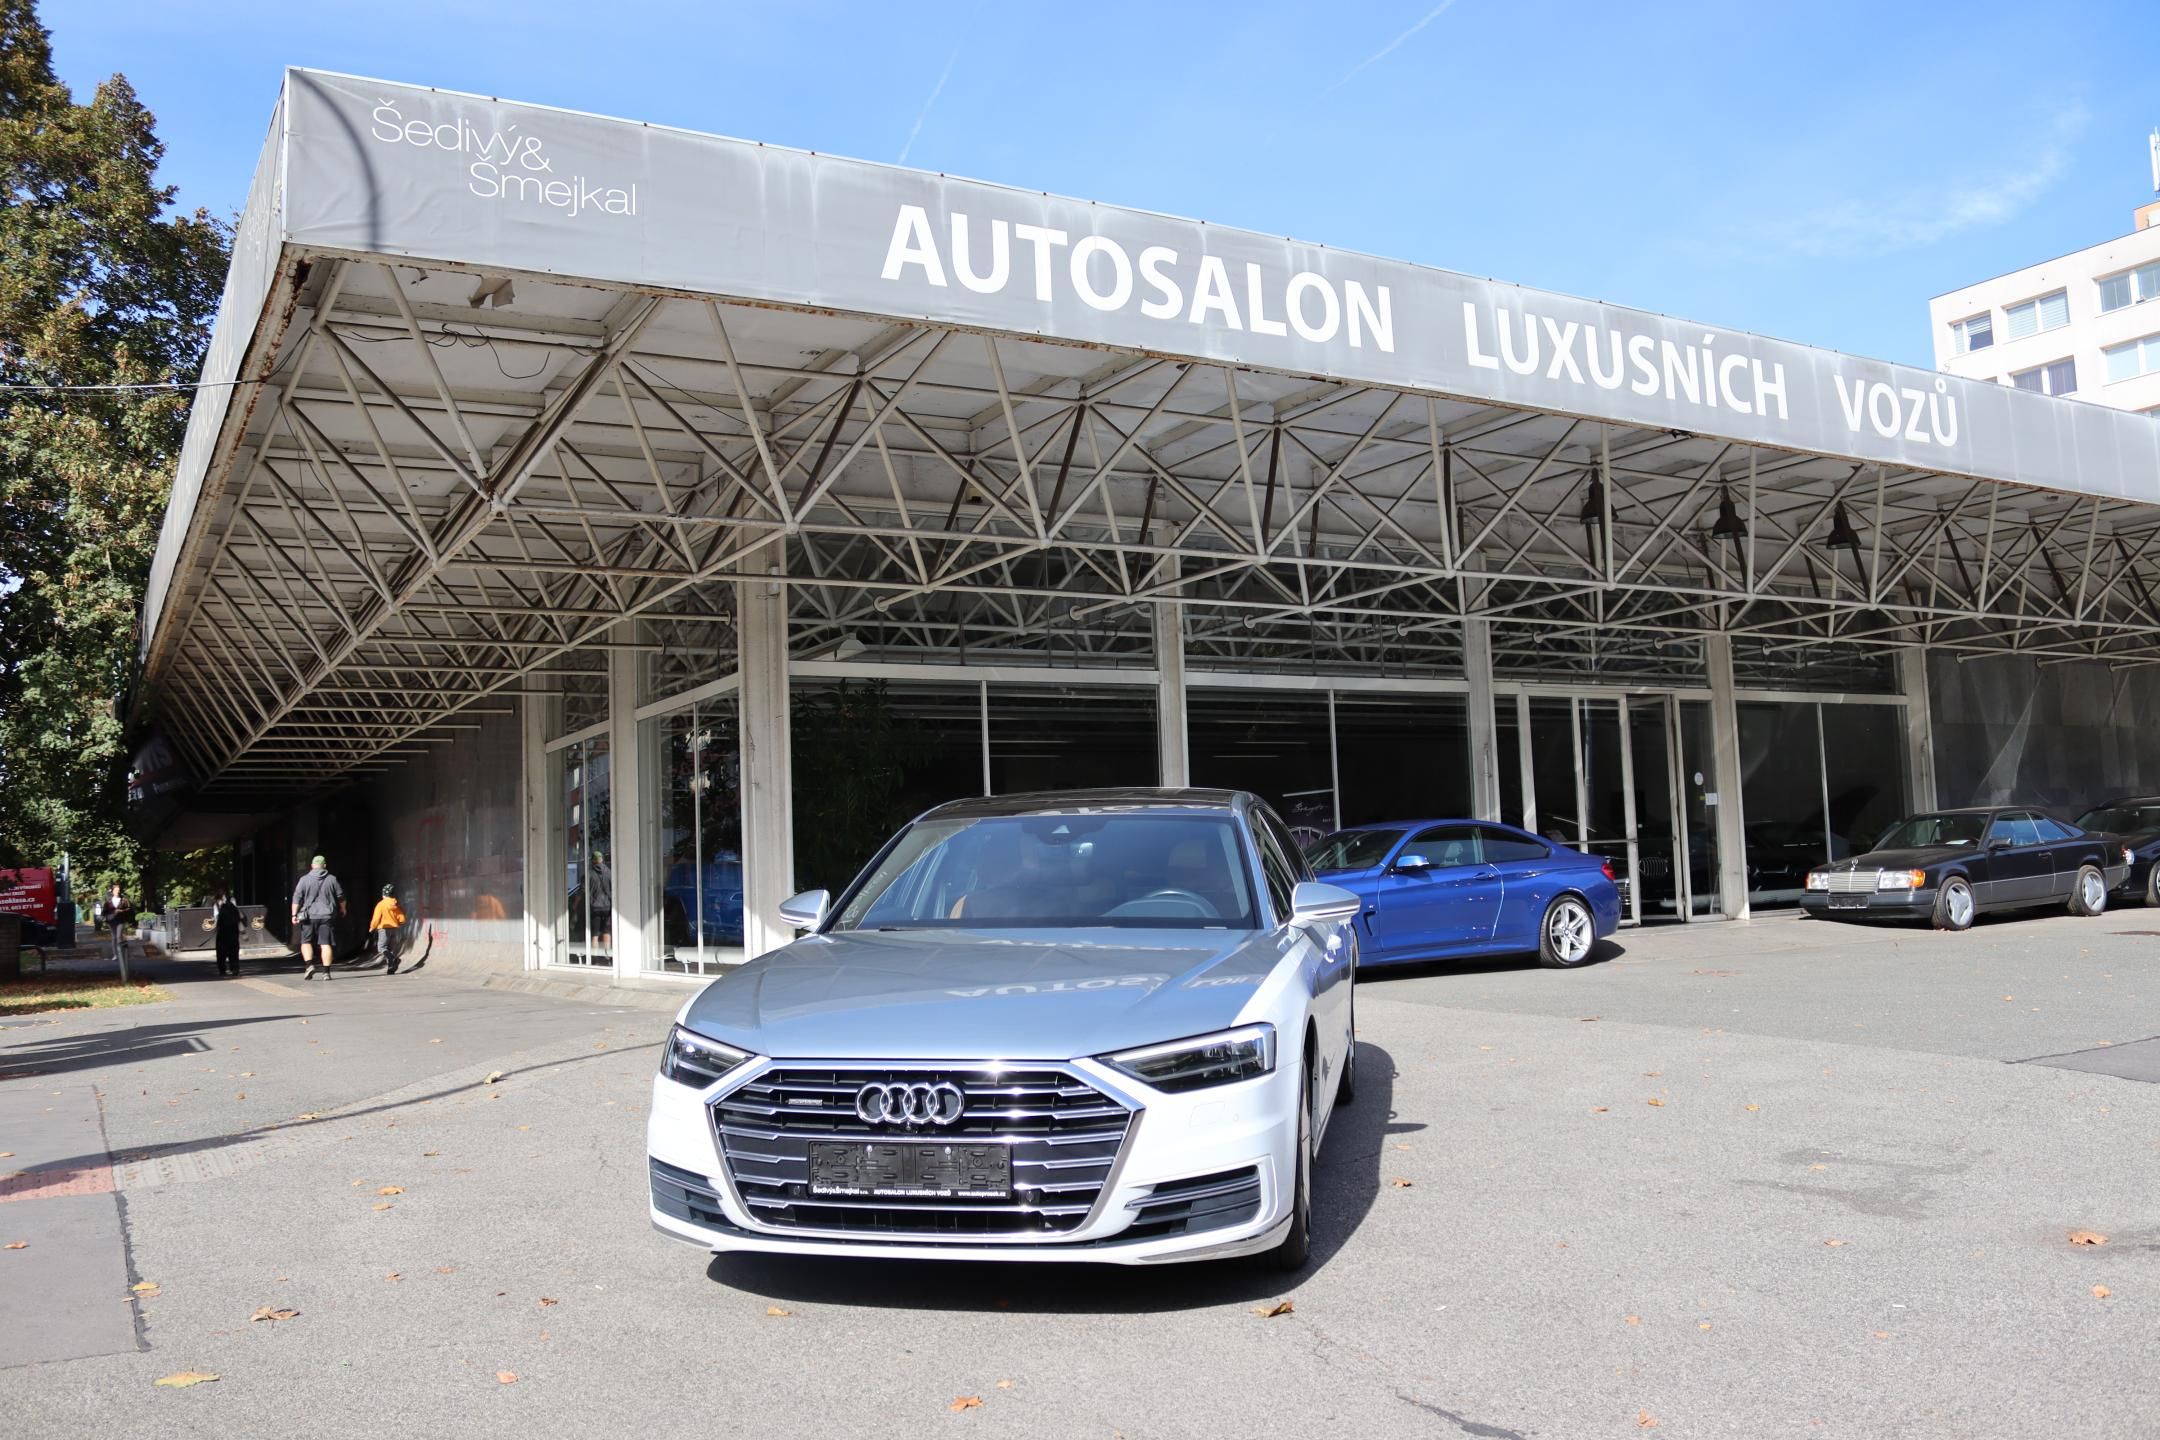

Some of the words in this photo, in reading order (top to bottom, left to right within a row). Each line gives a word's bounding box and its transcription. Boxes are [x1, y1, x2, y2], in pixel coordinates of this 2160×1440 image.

[372, 97, 552, 172] Šedivý&
[469, 153, 636, 217] Šmejkal
[881, 203, 1395, 353] AUTOSALON
[1463, 302, 1789, 420] LUXUSNÍCH
[1833, 378, 1959, 447] VOZŮ
